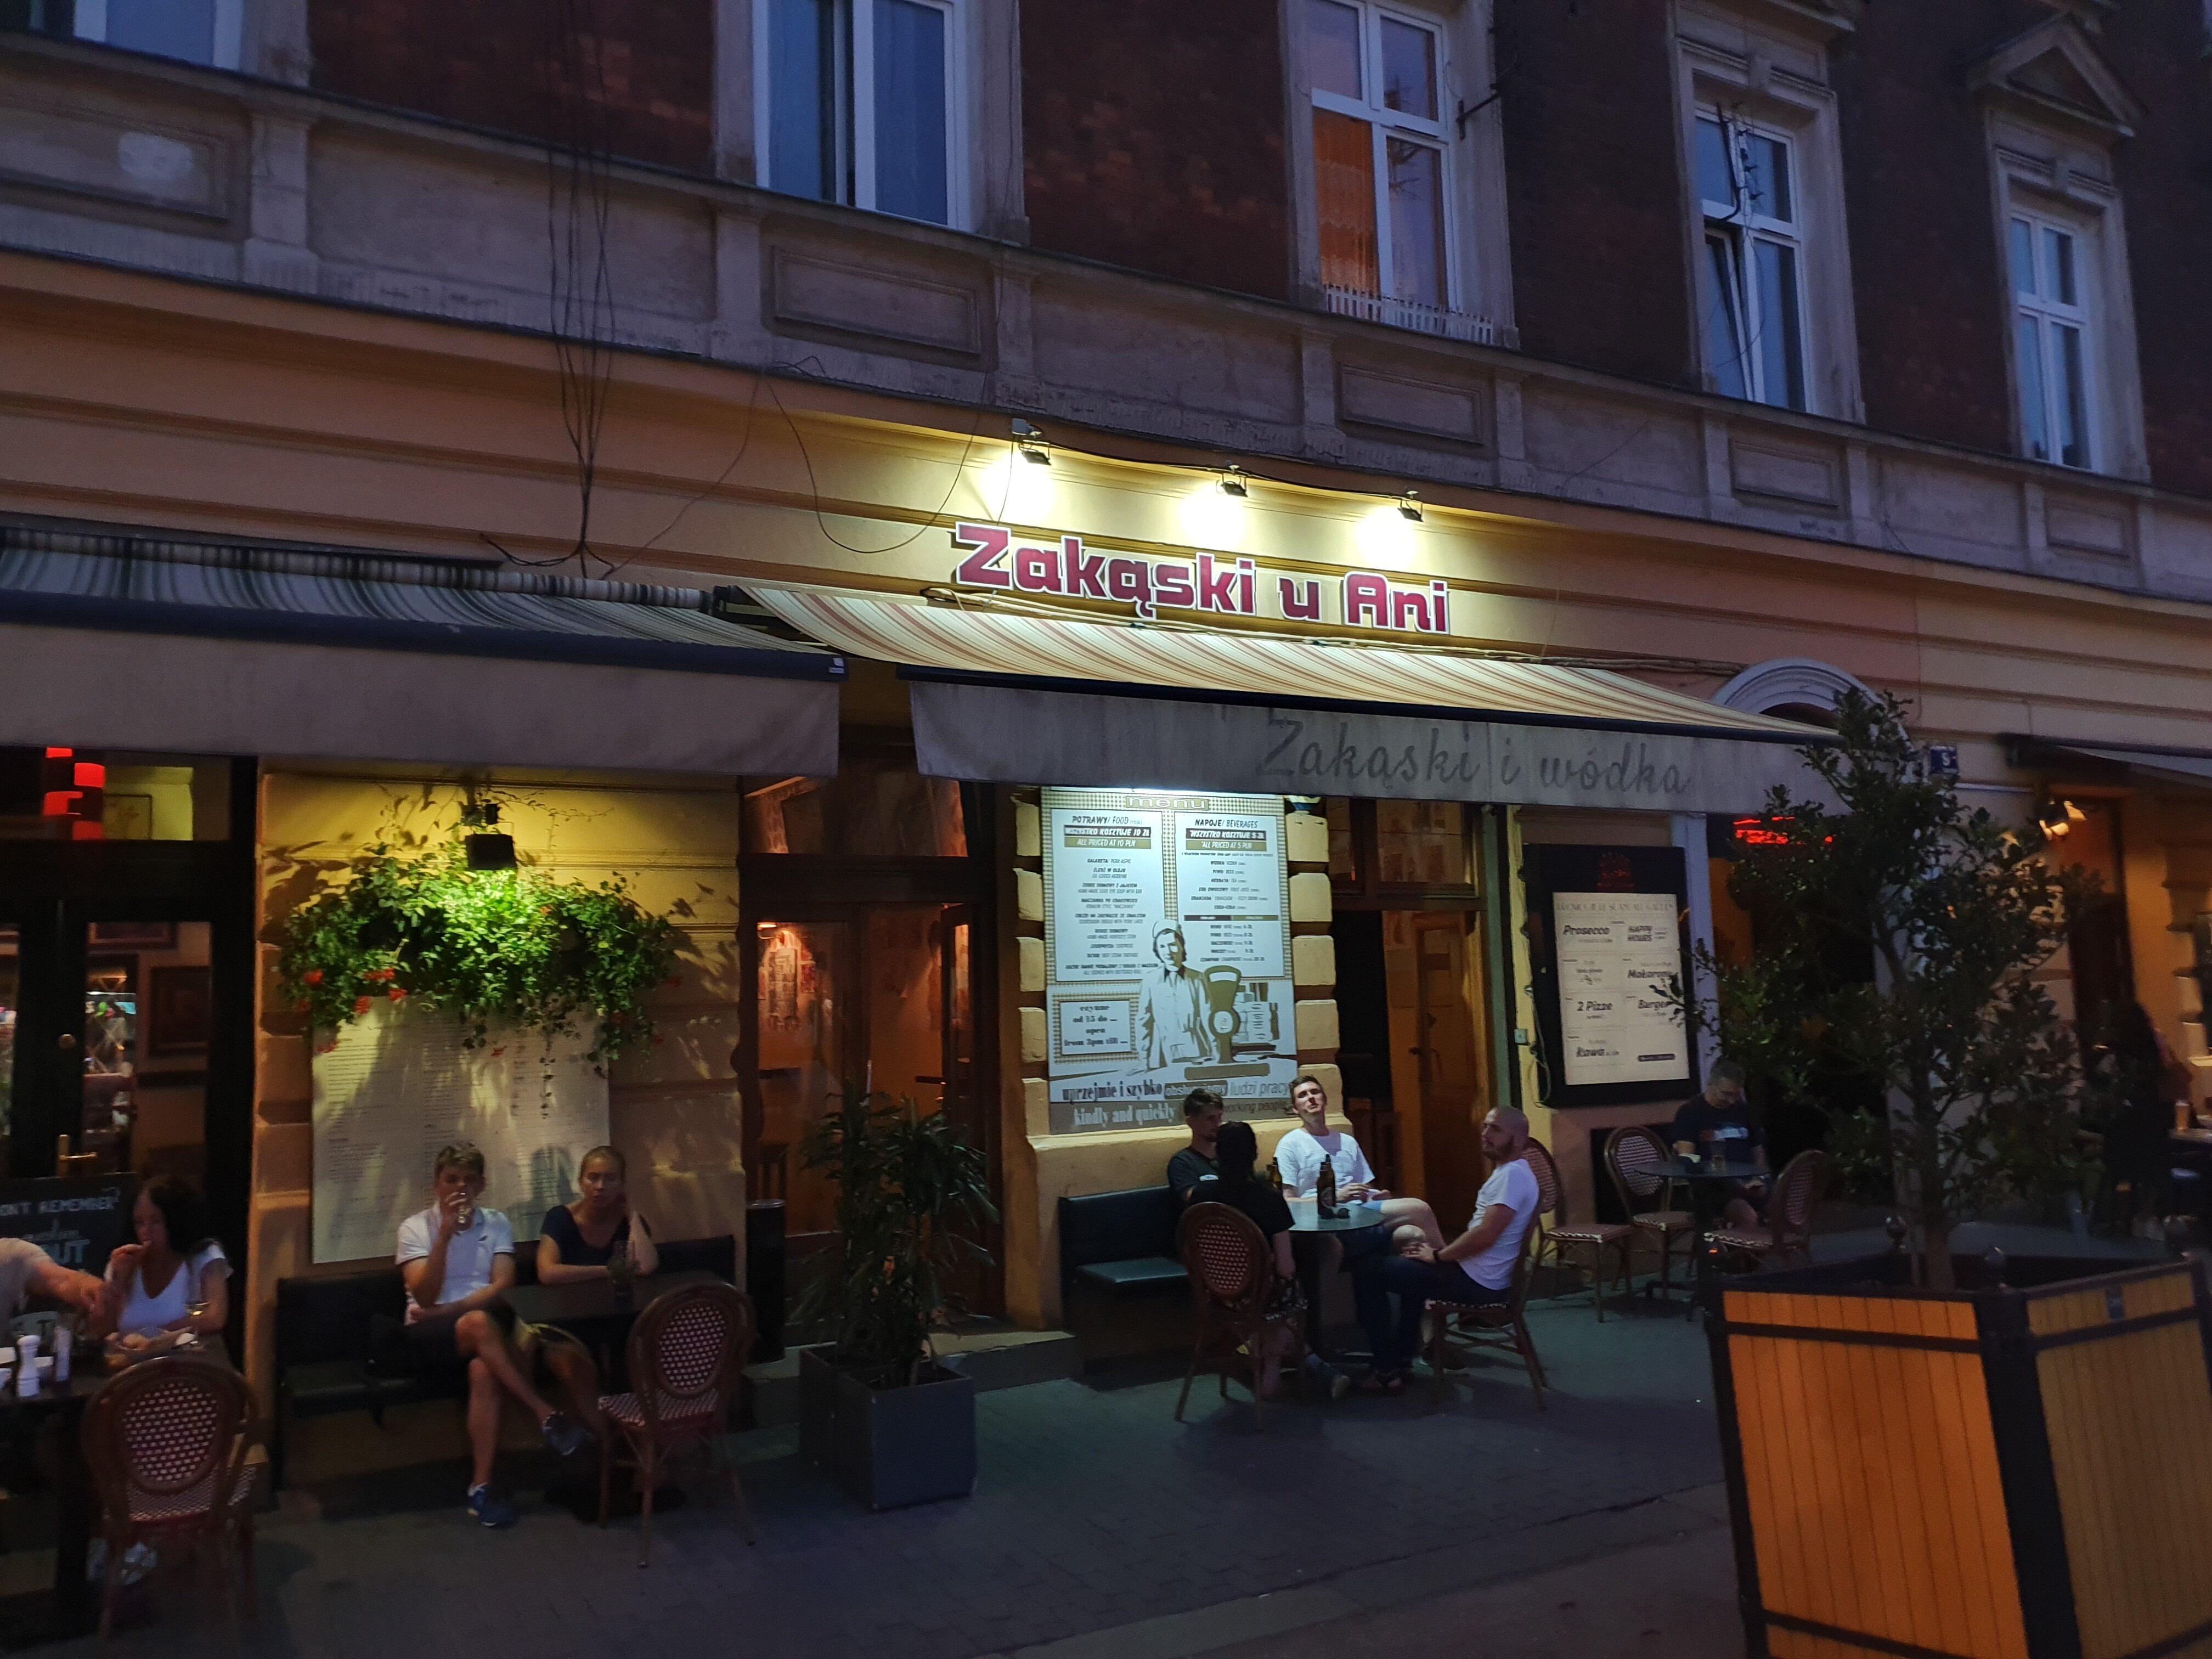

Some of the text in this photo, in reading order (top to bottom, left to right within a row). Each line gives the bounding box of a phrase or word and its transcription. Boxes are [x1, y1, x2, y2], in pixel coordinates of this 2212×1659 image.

[953, 522, 1449, 635] Zakąski u Ani
[1258, 713, 1692, 795] Zakąski i wódka
[1128, 797, 1205, 809] menu
[1112, 816, 1129, 824] FOOD
[1226, 820, 1258, 828] BEVERAGES
[1099, 828, 1132, 836] KOSZTUJE
[1088, 838, 1108, 847] PRICED
[1563, 925, 1610, 935] Prosecco
[1577, 1001, 1584, 1011] 2
[1074, 1107, 1108, 1127] kindly
[1112, 1105, 1133, 1122] and
[1136, 1103, 1175, 1125] quickly
